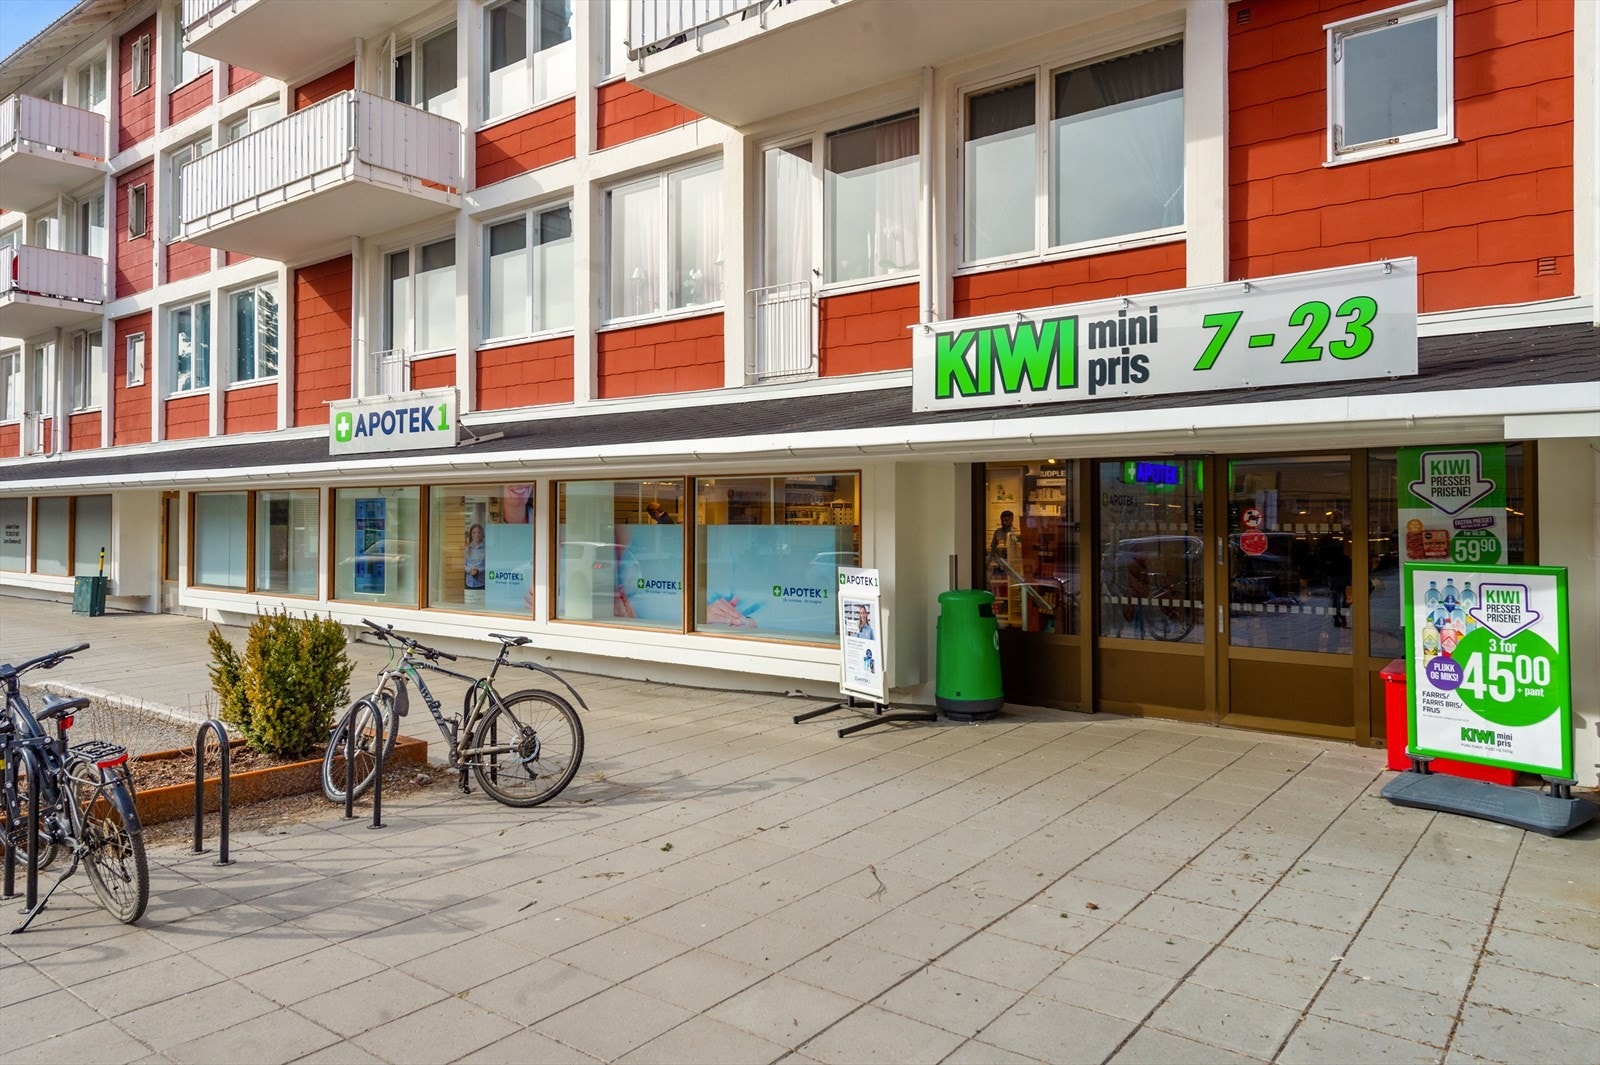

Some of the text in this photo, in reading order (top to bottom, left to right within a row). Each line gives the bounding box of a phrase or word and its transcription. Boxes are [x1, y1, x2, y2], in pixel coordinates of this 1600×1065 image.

[1088, 305, 1158, 351] mini
[1193, 295, 1378, 371] 7 - 23
[935, 315, 1079, 400] KIWI
[1088, 347, 1150, 395] pris
[354, 404, 450, 437] APOTEK 1
[1137, 462, 1177, 484] APOTEK
[1430, 459, 1471, 476] KIWI
[1430, 475, 1471, 486] PRESSER
[1431, 486, 1471, 497] PRISENE!
[495, 572, 520, 581] APOTEK
[847, 575, 878, 587] APOTEK 1
[645, 579, 682, 590] APOTEK 1
[783, 587, 829, 599] APOTEK 1
[1486, 590, 1520, 605] KIWI
[1486, 604, 1521, 614] PRESSER
[1486, 613, 1521, 624] PRISENE!
[1489, 639, 1517, 653] 3 for
[1433, 662, 1455, 672] PLUKK
[1430, 671, 1459, 682] OG MIKS!
[1422, 690, 1450, 699] FARRIS/
[1525, 687, 1544, 697] pant
[1422, 698, 1463, 709] FARRIS BRIS/
[1422, 705, 1441, 714] FRUS
[1461, 727, 1495, 745] KIWI
[1497, 733, 1513, 741] mini
[1497, 740, 1512, 748] pris
